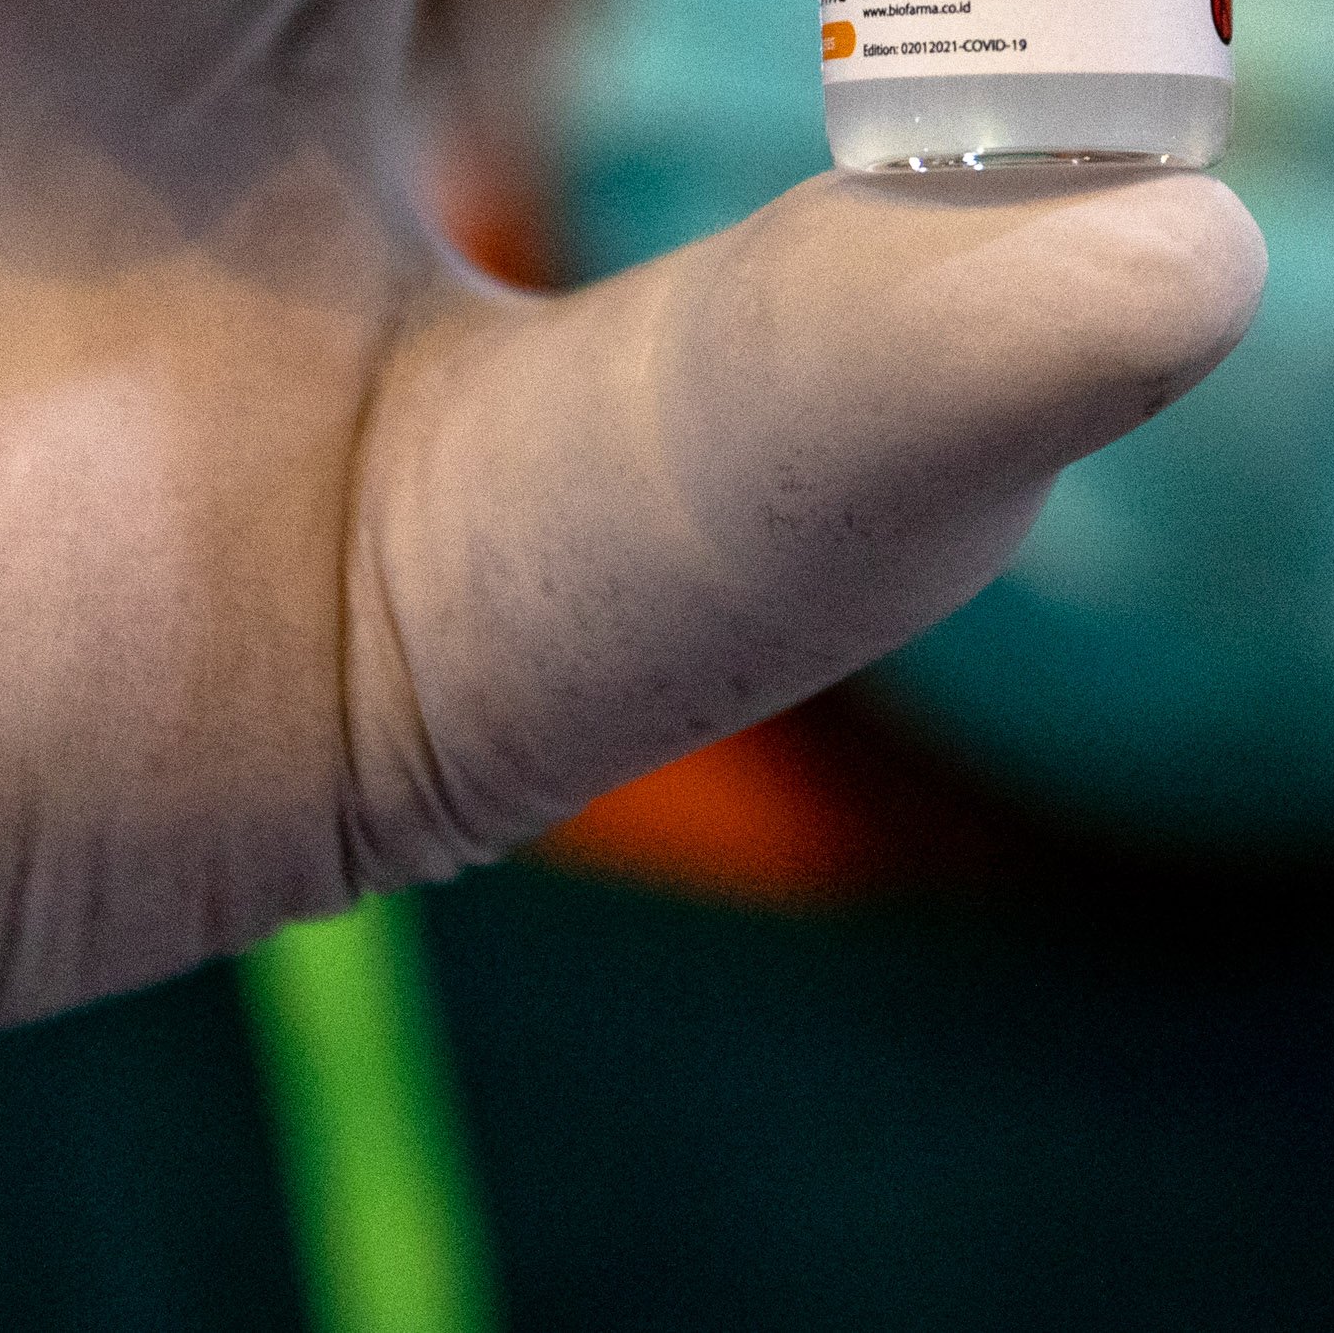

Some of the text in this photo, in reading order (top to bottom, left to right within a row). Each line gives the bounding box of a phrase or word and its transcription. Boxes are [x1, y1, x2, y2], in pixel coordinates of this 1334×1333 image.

[862, 1, 971, 18] www.biofarma.co.id
[863, 38, 1027, 57] Edition: 02012021-COVID-19
